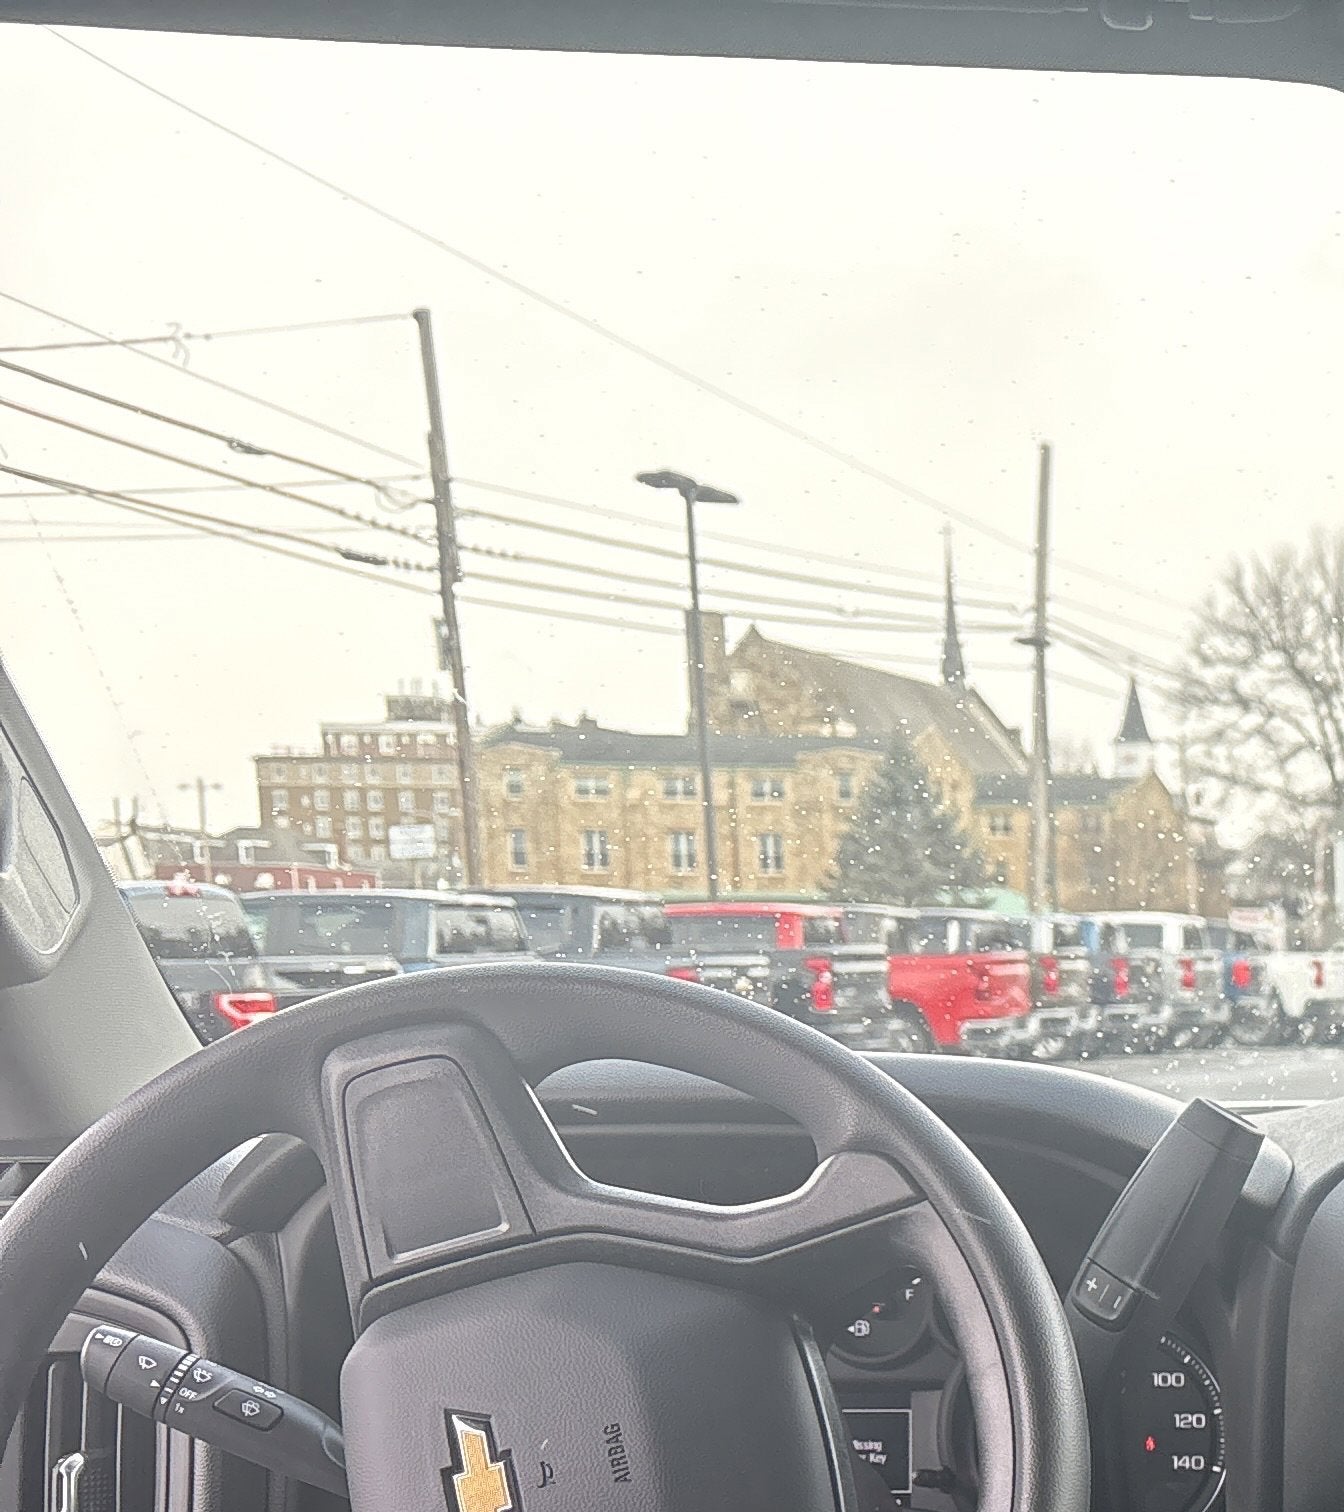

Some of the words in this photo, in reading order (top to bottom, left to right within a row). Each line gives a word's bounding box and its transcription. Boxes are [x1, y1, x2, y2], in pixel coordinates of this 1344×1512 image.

[905, 1288, 915, 1301] F
[1152, 1371, 1185, 1388] 100
[178, 1386, 199, 1401] OFF
[1173, 1413, 1206, 1429] 120
[603, 1422, 633, 1483] AIRBAG
[1171, 1455, 1205, 1471] 140
